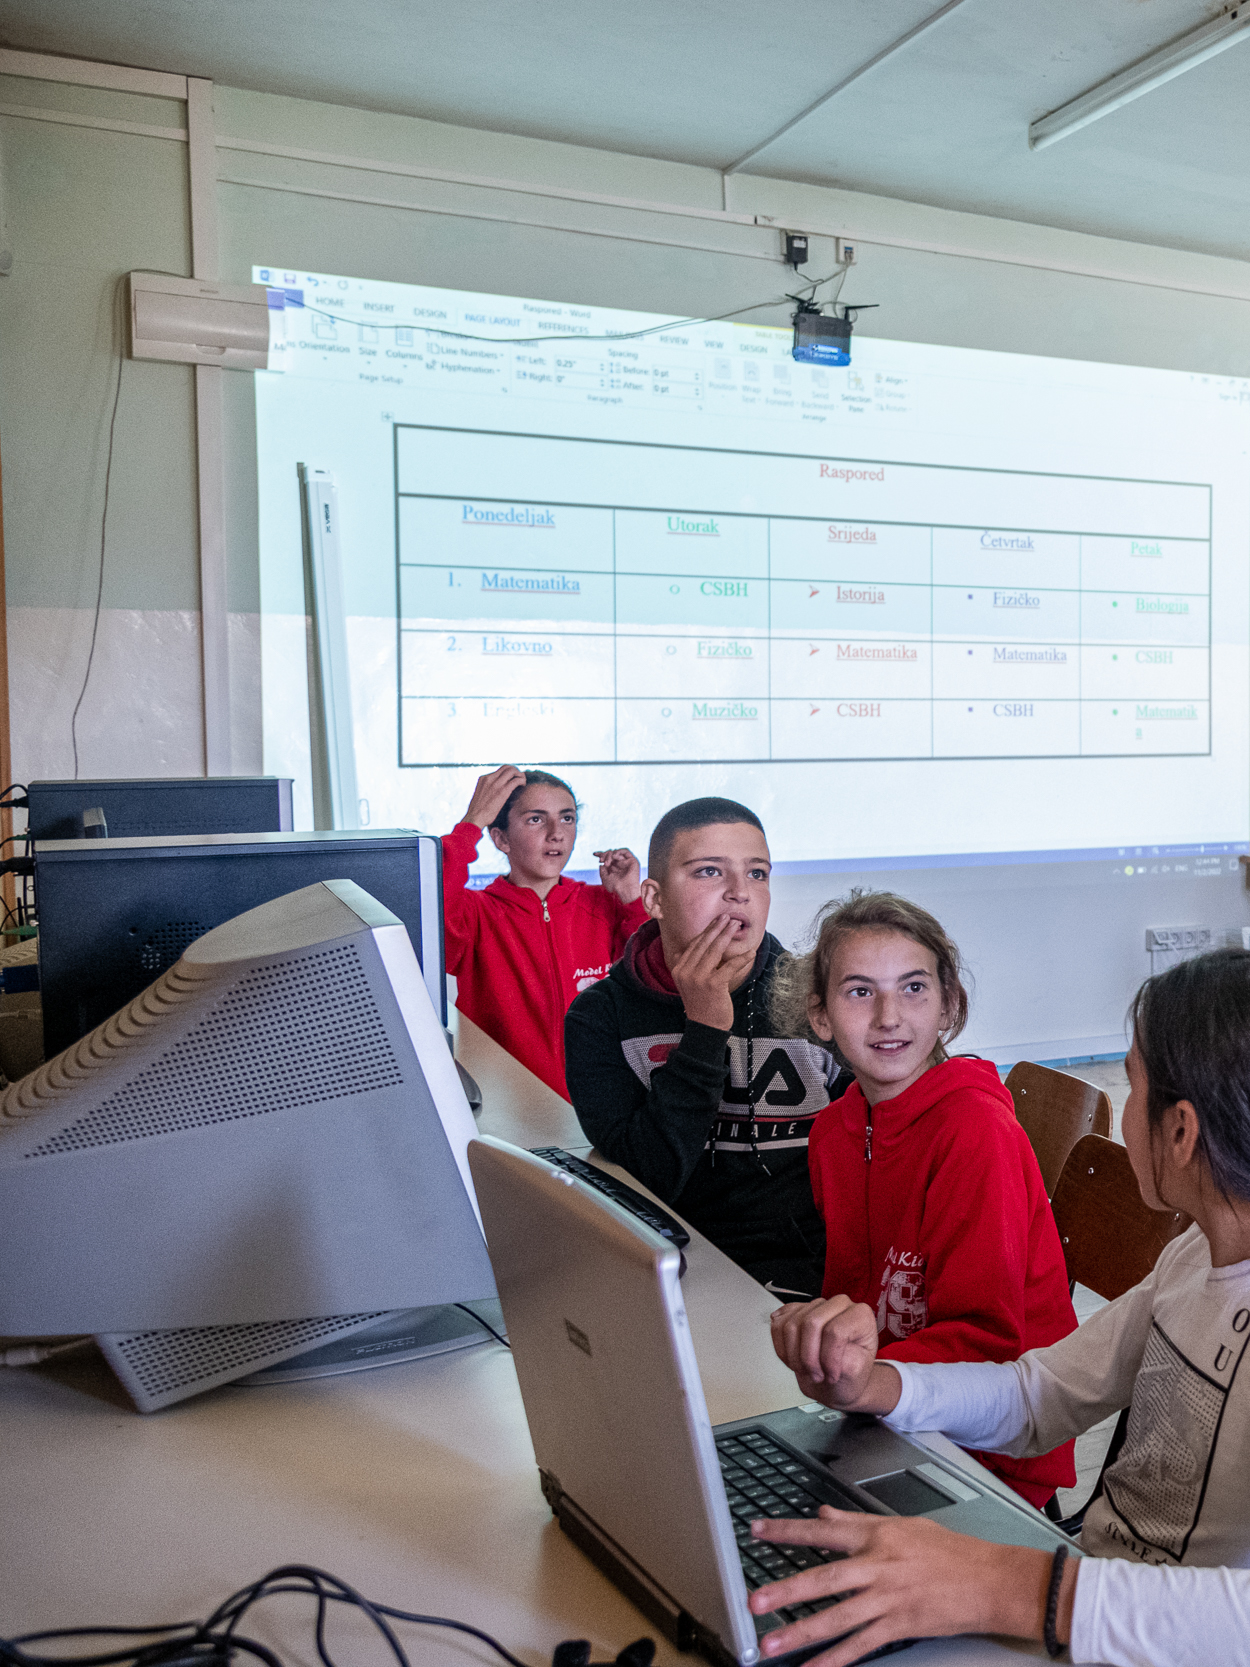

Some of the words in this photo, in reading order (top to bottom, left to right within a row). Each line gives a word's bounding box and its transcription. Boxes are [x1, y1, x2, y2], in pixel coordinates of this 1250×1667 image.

[315, 297, 345, 308] HOME
[363, 302, 395, 313] INSERT
[413, 307, 447, 319] DESIGN
[523, 304, 562, 316] Raspored
[570, 309, 592, 319] Word
[464, 313, 486, 324] PAGE
[489, 315, 521, 328] LAYOUT
[537, 321, 590, 335] REFERENCES
[299, 341, 350, 354] Orientation
[659, 335, 689, 346] REVIEW
[704, 340, 724, 350] VIEW
[359, 347, 377, 357] Size
[385, 349, 423, 361] Columns
[441, 346, 458, 356] Line
[460, 348, 498, 360] Numbers
[739, 343, 768, 354] DESIGN
[441, 362, 495, 376] Hyphenation
[819, 463, 885, 484] Raspored
[462, 504, 556, 528] Ponedeljak
[667, 516, 720, 535] Utorak
[828, 525, 877, 543] Srijeda
[980, 531, 1035, 549] Četvrtak
[1130, 541, 1163, 556] Petak
[447, 572, 462, 588] 1.
[481, 573, 580, 592] Matematika
[700, 581, 749, 598] CSBH
[836, 586, 885, 604] Istorija
[993, 592, 1040, 608] Fizičko
[1135, 597, 1189, 615] Biologija
[447, 636, 462, 653] 2.
[482, 636, 553, 654] Likovno
[697, 640, 753, 658] Fizičko
[836, 644, 918, 660] Matematika
[993, 647, 1067, 662] Matematika
[1135, 650, 1173, 665] CSBH
[692, 702, 758, 719] Muzičko
[837, 703, 882, 718] CSBH
[993, 703, 1034, 717] CSBH
[1135, 704, 1198, 719] Matematik
[573, 965, 603, 979] Model
